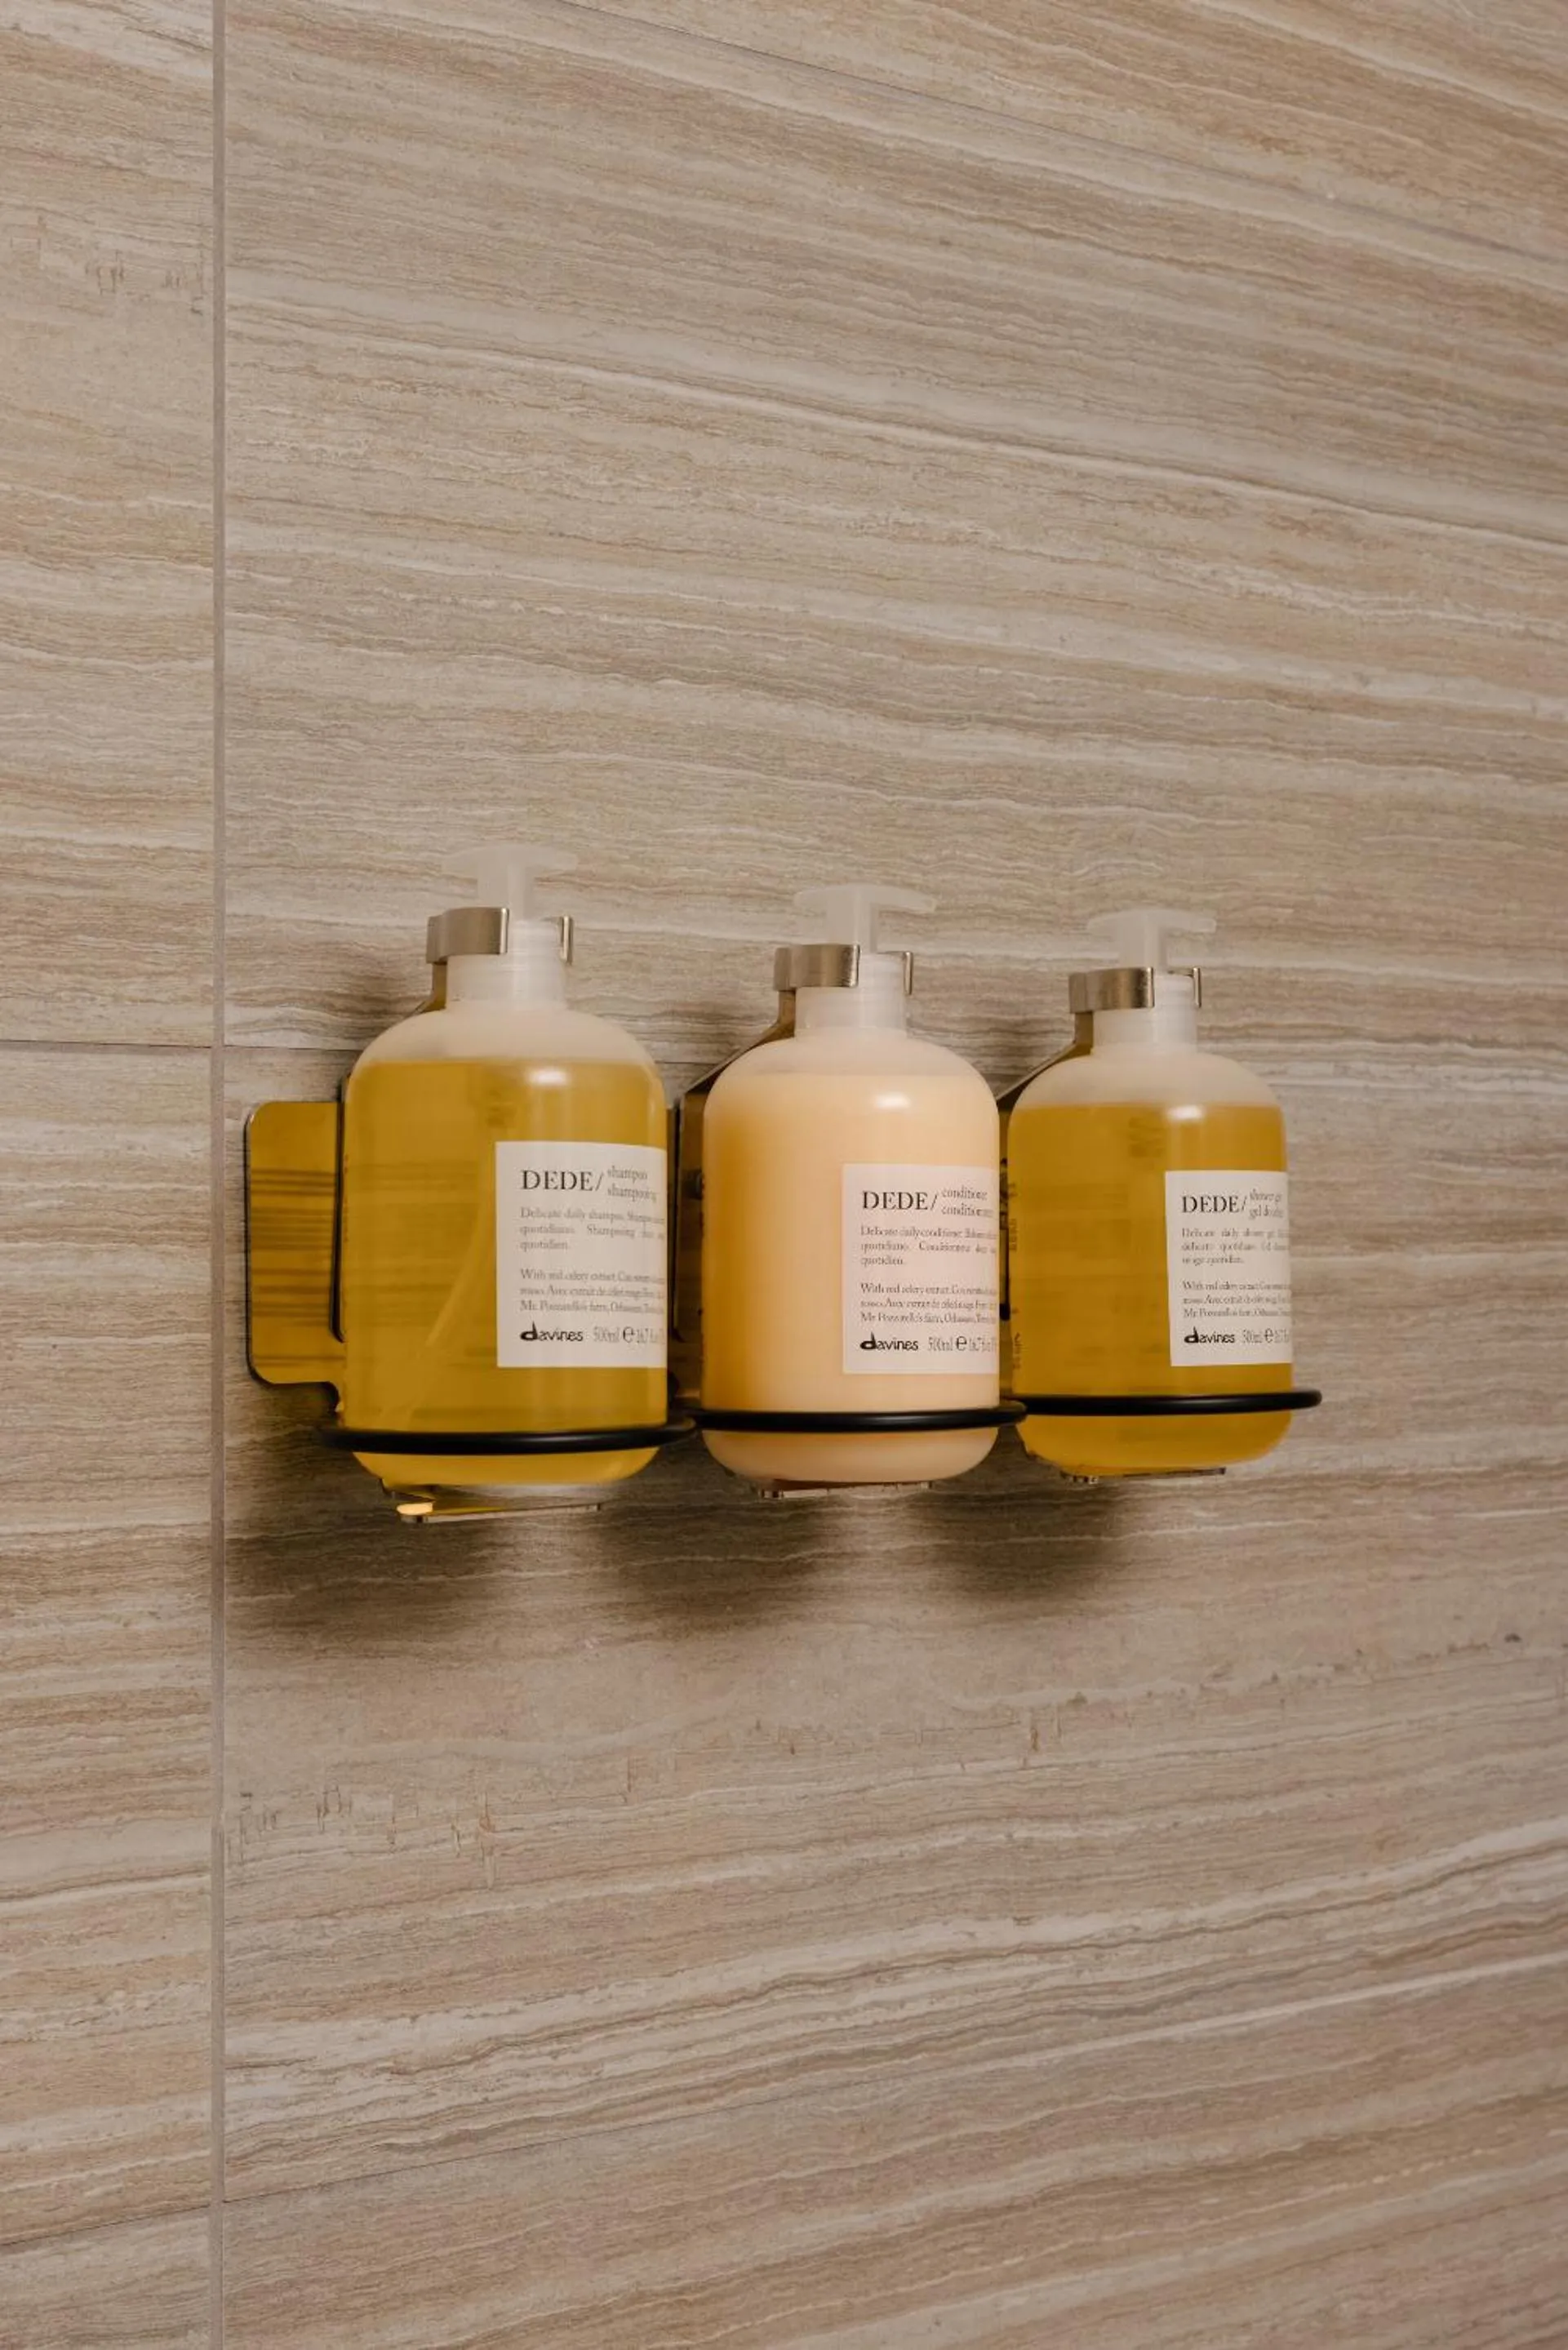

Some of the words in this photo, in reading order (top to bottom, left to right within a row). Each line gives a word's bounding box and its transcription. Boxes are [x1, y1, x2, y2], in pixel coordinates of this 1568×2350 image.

[520, 1268, 547, 1281] With
[860, 1282, 885, 1294] With
[520, 1321, 584, 1342] davines
[1184, 1326, 1235, 1344] davines
[860, 1331, 919, 1351] davines
